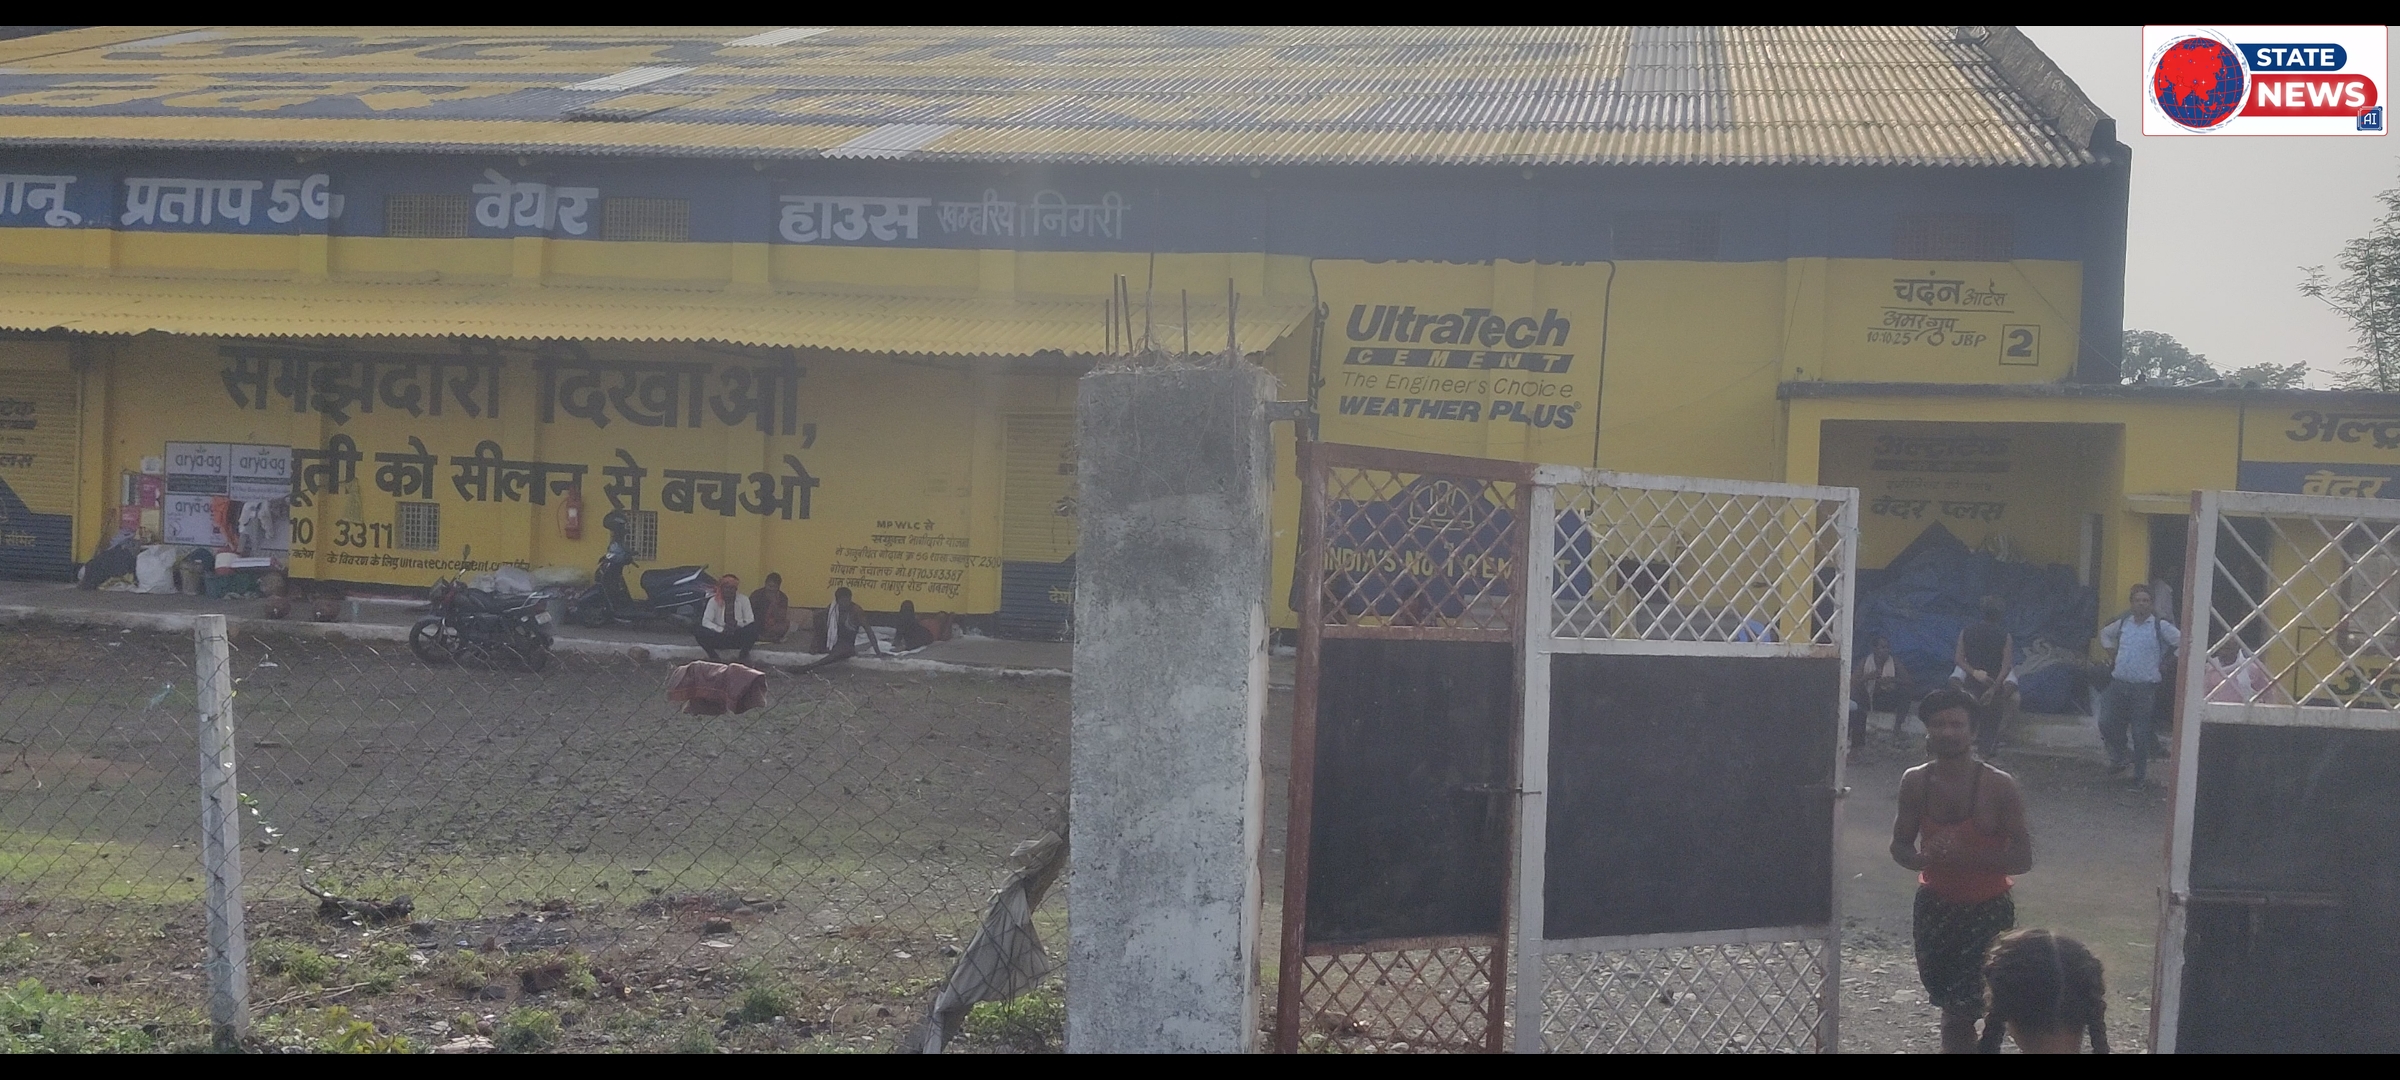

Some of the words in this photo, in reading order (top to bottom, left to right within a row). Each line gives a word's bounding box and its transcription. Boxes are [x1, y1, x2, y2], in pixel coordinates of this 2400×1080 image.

[121, 176, 263, 226] प्रताप
[267, 173, 345, 225] 5G
[472, 169, 599, 236] वेयर
[779, 194, 932, 242] हाउस
[1031, 188, 1131, 240] निगरी
[1346, 303, 1571, 348] UltraTech
[1883, 310, 1928, 329] अमर
[1951, 332, 1987, 347] JBP
[2007, 328, 2034, 358] 2
[1356, 349, 1562, 372] CEMENT
[219, 341, 505, 425] समझदारी
[1342, 371, 1378, 388] The
[1385, 373, 1489, 395] Engineer's
[1493, 377, 1573, 398] Choice
[1338, 395, 1481, 422] WEATHER
[375, 437, 438, 500] को
[451, 440, 589, 506] सीलन
[603, 449, 655, 509] से
[334, 519, 393, 549] 3311
[326, 551, 338, 563] के
[339, 551, 369, 566] विवरण
[369, 553, 382, 567] के
[382, 554, 400, 570] लिए
[1323, 547, 1396, 573] INDIA'S
